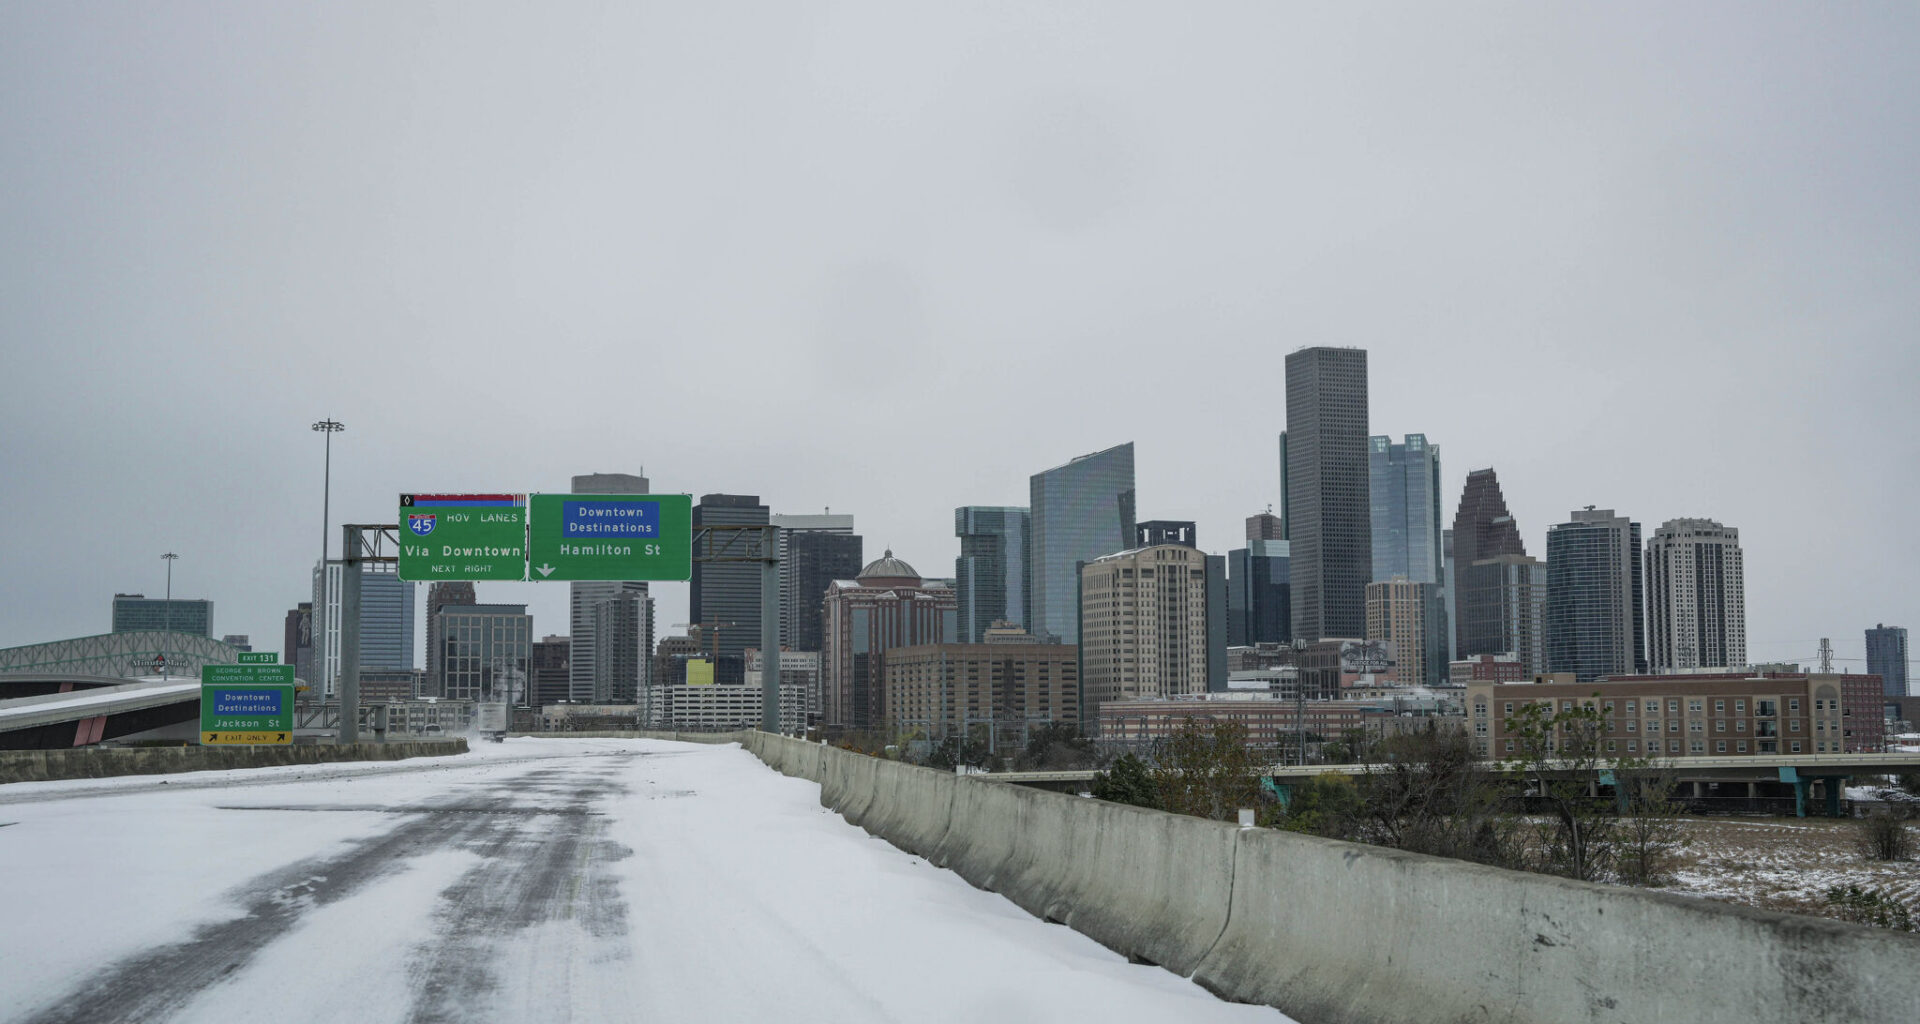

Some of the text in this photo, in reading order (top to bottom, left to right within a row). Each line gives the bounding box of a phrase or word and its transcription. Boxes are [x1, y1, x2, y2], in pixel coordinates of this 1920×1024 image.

[579, 507, 643, 517] Downtown
[447, 513, 518, 522] HOV LANES
[412, 519, 432, 532] 45
[569, 522, 652, 532] Destinations
[405, 545, 520, 556] Via Downtown
[560, 544, 661, 555] Hamilton St
[431, 565, 493, 573] NEXT RIGHT
[167, 659, 189, 667] Maid
[218, 704, 277, 712] Destinations
[214, 719, 280, 727] Jackson St
